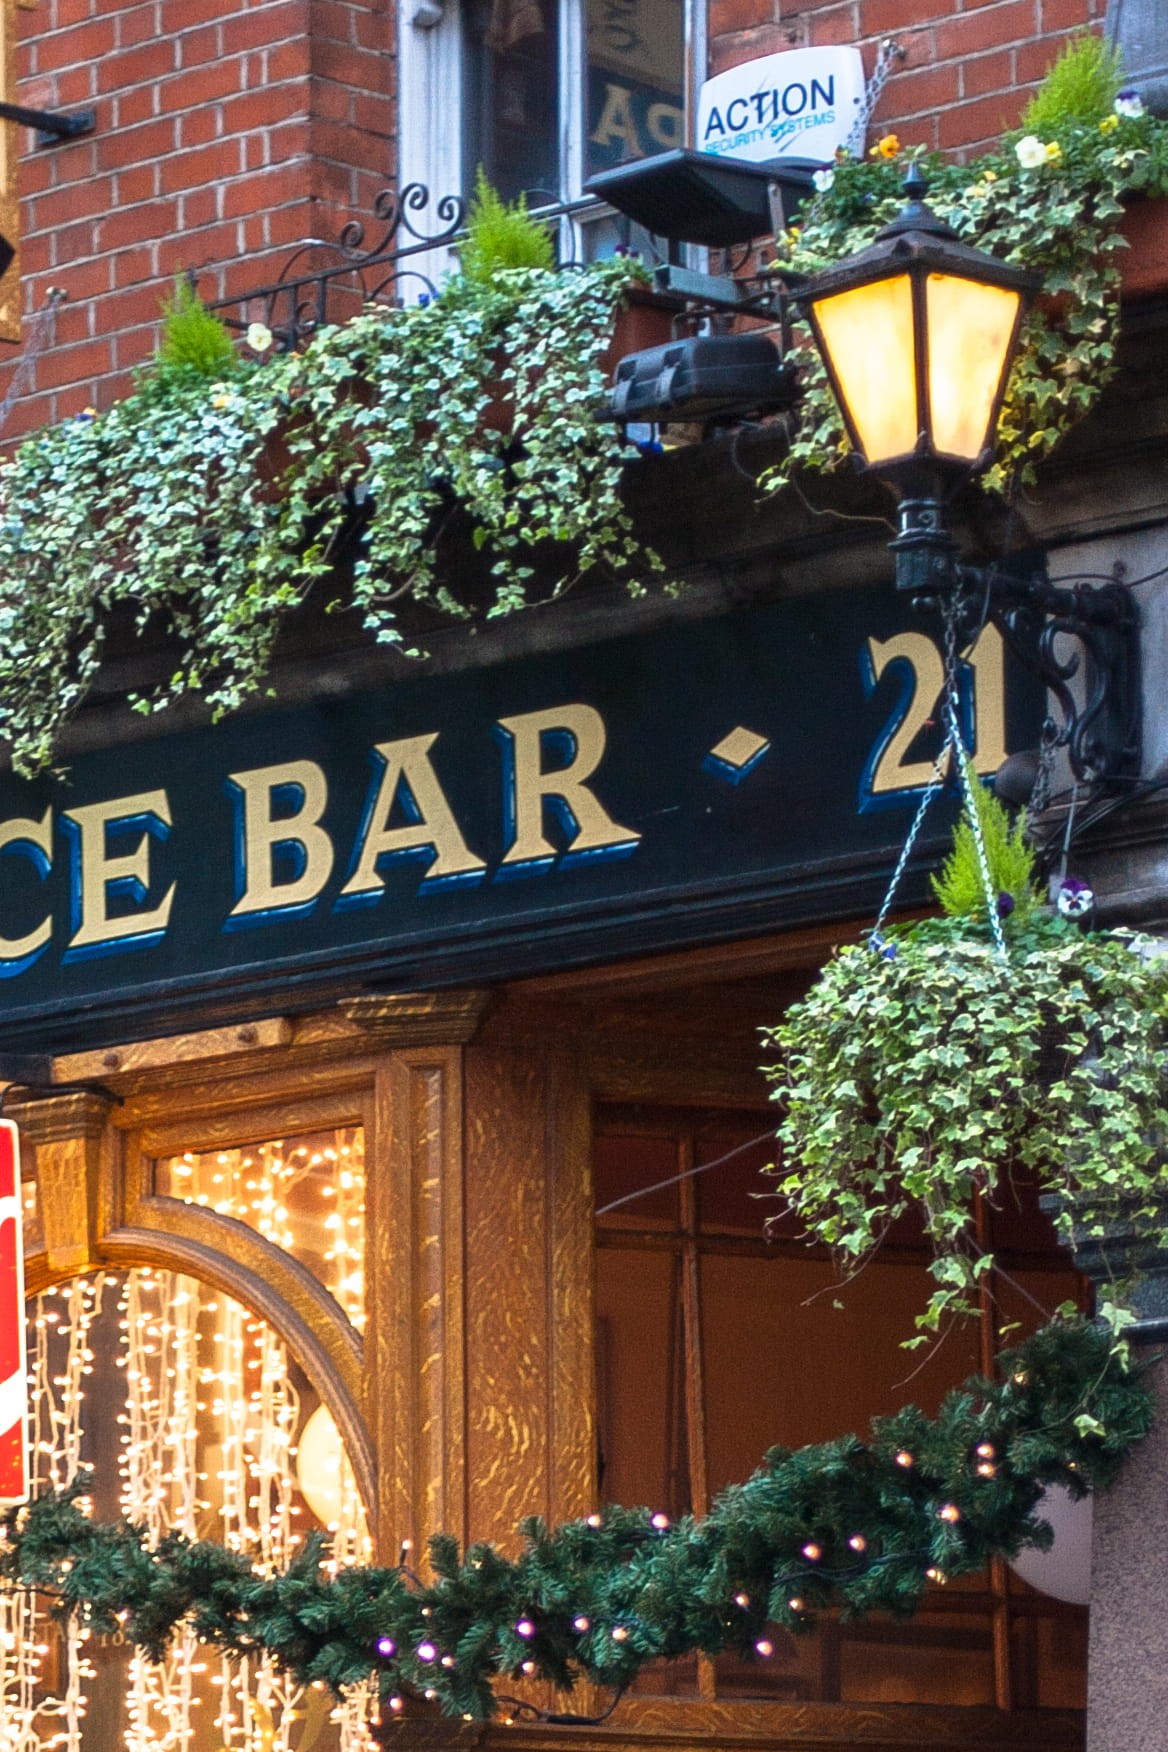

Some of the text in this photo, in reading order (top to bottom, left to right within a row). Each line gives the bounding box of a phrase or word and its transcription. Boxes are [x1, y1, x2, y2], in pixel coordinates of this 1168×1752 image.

[704, 75, 835, 141] ACTION
[705, 110, 835, 155] SECURITY SYSTEMS
[227, 703, 642, 922] BAR
[860, 620, 1010, 812] 21
